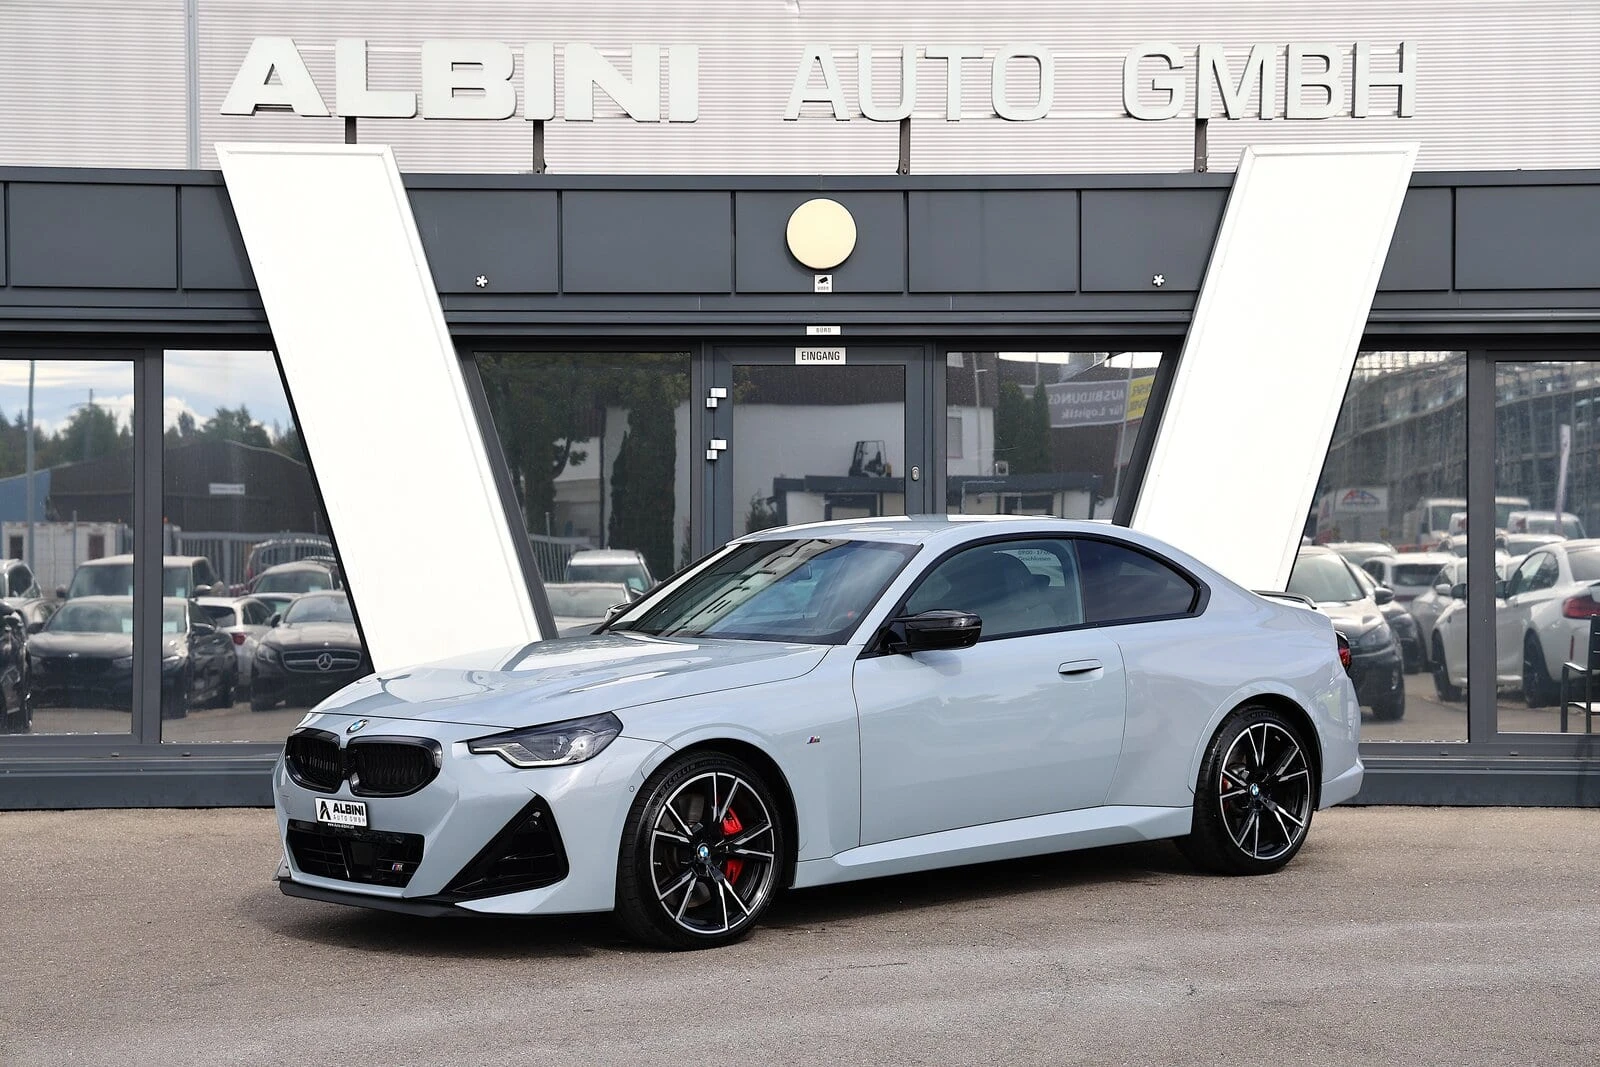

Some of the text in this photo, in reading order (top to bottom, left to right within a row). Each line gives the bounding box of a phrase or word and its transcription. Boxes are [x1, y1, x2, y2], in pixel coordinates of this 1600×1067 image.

[220, 37, 1417, 122] ALBINI AUTO GMBH
[801, 351, 840, 361] EINGANG
[333, 803, 364, 816] ALBINI
